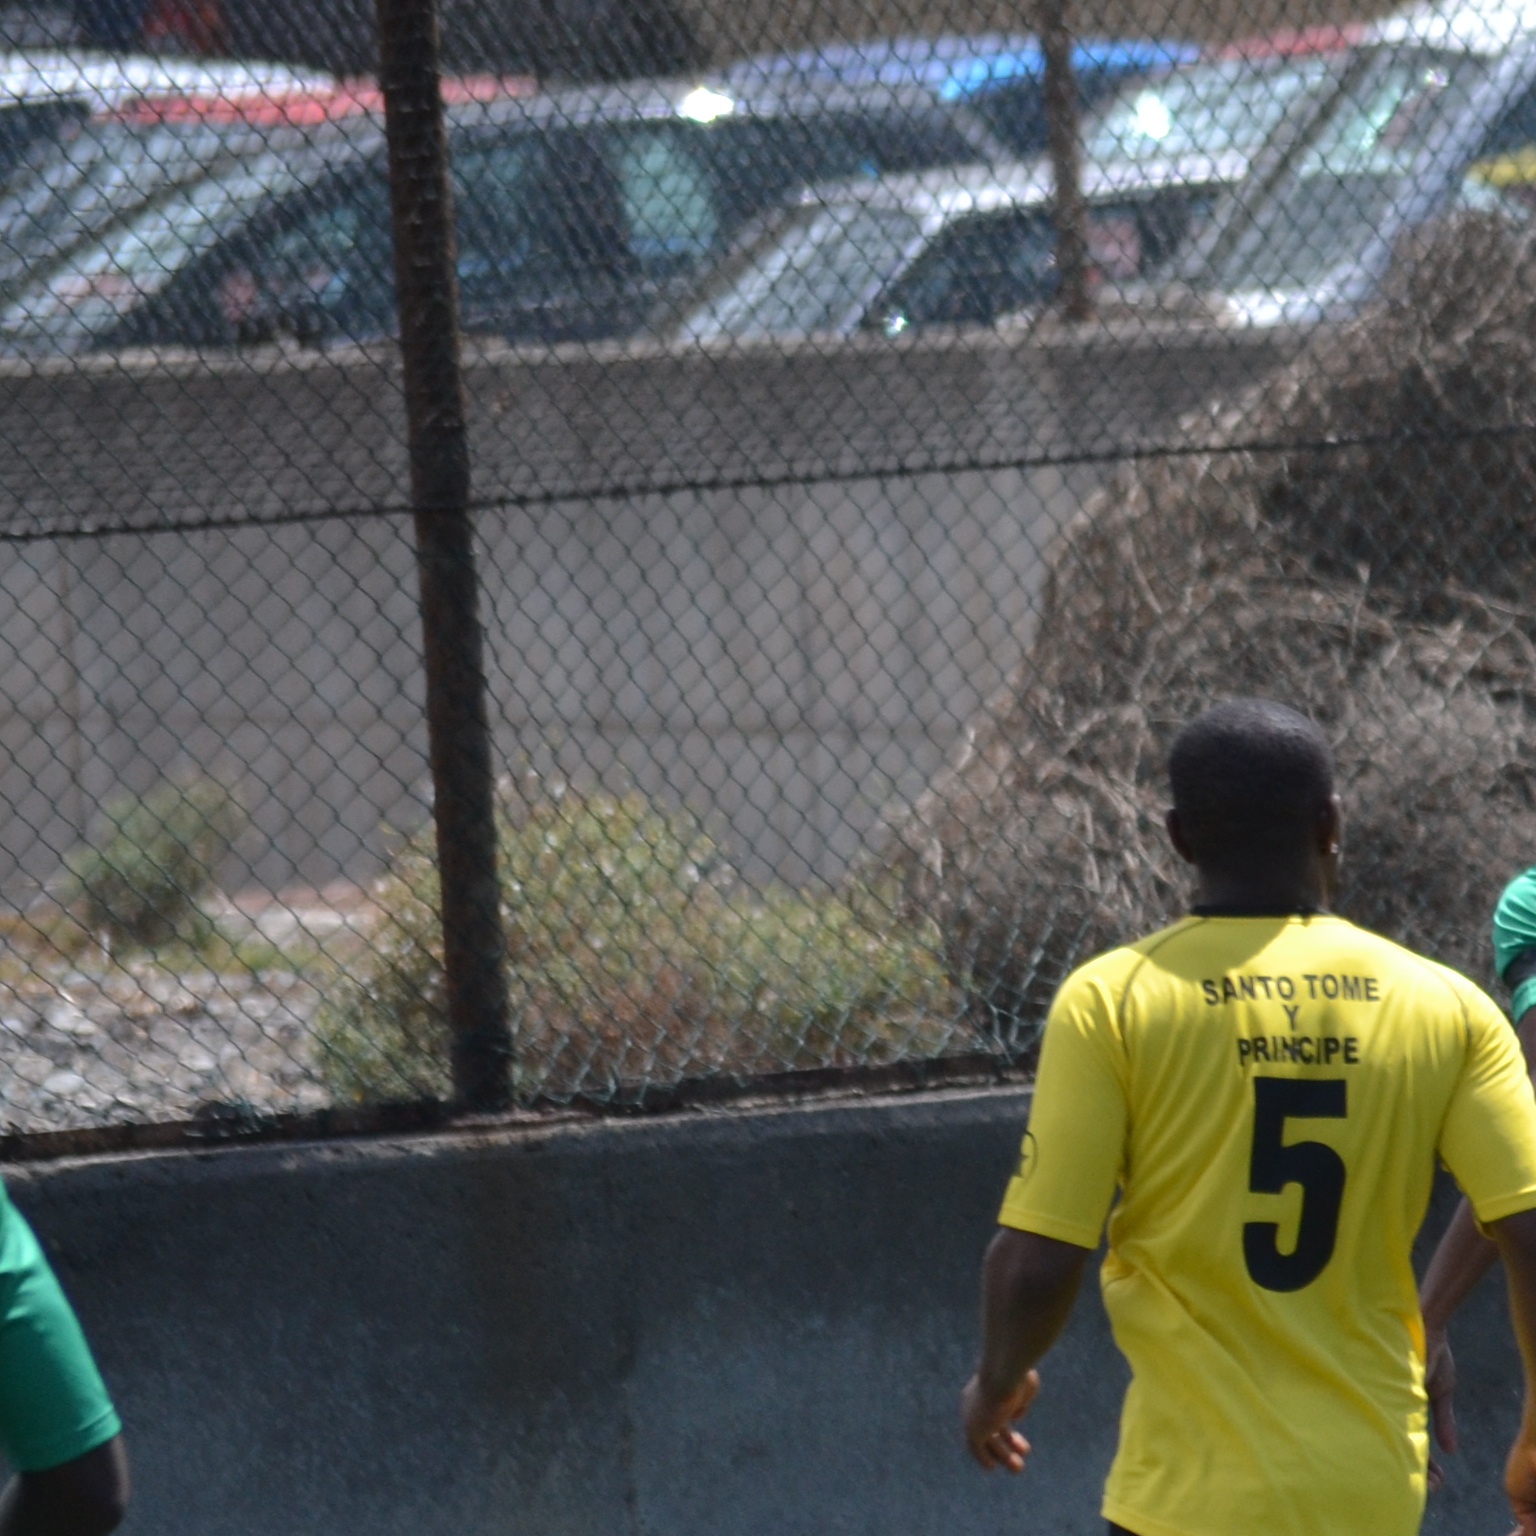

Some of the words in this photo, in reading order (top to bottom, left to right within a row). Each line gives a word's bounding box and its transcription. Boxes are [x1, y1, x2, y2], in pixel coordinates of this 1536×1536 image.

[1203, 975, 1295, 1006] SANTO
[1303, 974, 1381, 1002] TOME
[1282, 1004, 1299, 1031] Y
[1237, 1035, 1360, 1066] PRINCIPE
[1243, 1076, 1347, 1293] 5
